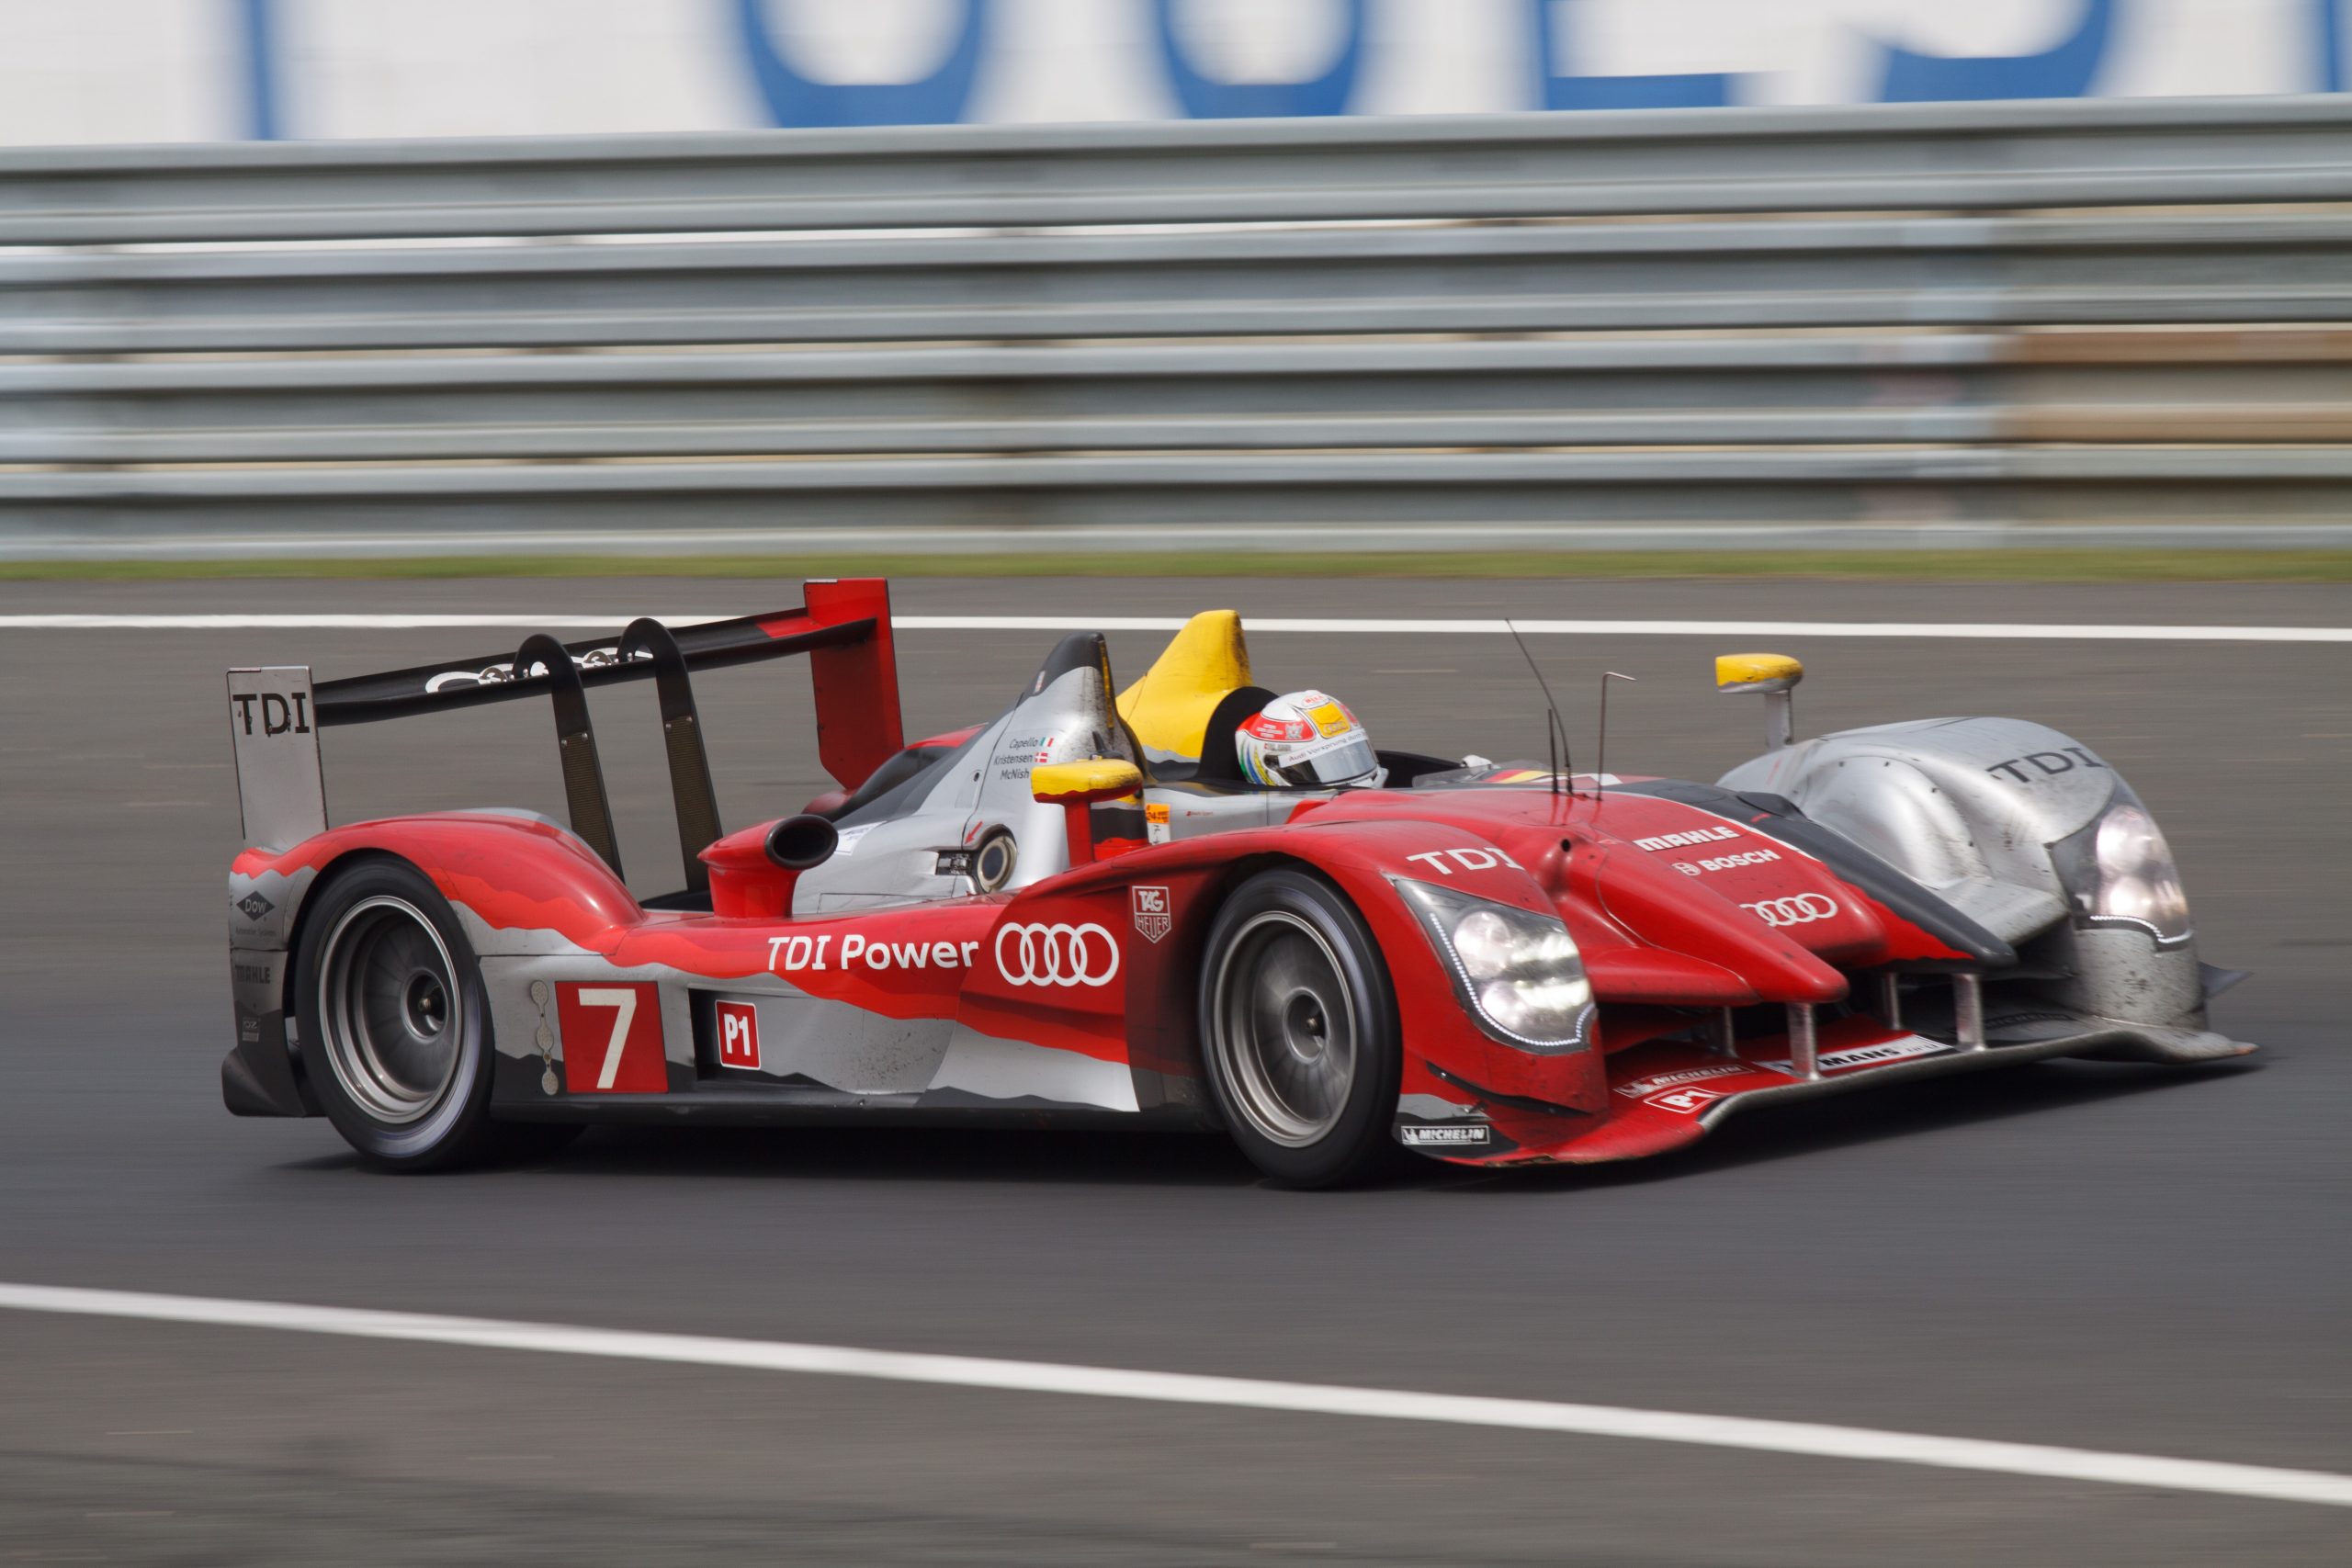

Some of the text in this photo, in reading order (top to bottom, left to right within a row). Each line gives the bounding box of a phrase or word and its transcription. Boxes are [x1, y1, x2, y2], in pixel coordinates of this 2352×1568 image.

[232, 693, 310, 736] TDI
[1009, 737, 1038, 750] Capello
[993, 754, 1034, 765] Kristensen
[1984, 747, 2105, 783] TDI
[1000, 768, 1030, 780] McNish
[1632, 826, 1741, 852] MAHLE
[1405, 847, 1526, 875] TDI
[1698, 849, 1782, 873] BOSCH
[1138, 890, 1164, 912] TAG
[1136, 917, 1169, 938] HEUER
[767, 934, 979, 971] TDI Power
[578, 987, 638, 1089] 7
[723, 1013, 751, 1056] P1
[1819, 1047, 1901, 1066] MANS
[1652, 1066, 1743, 1086] MICHELIN
[1659, 1089, 1721, 1108] P1
[1419, 1128, 1486, 1140] MICHELIN
